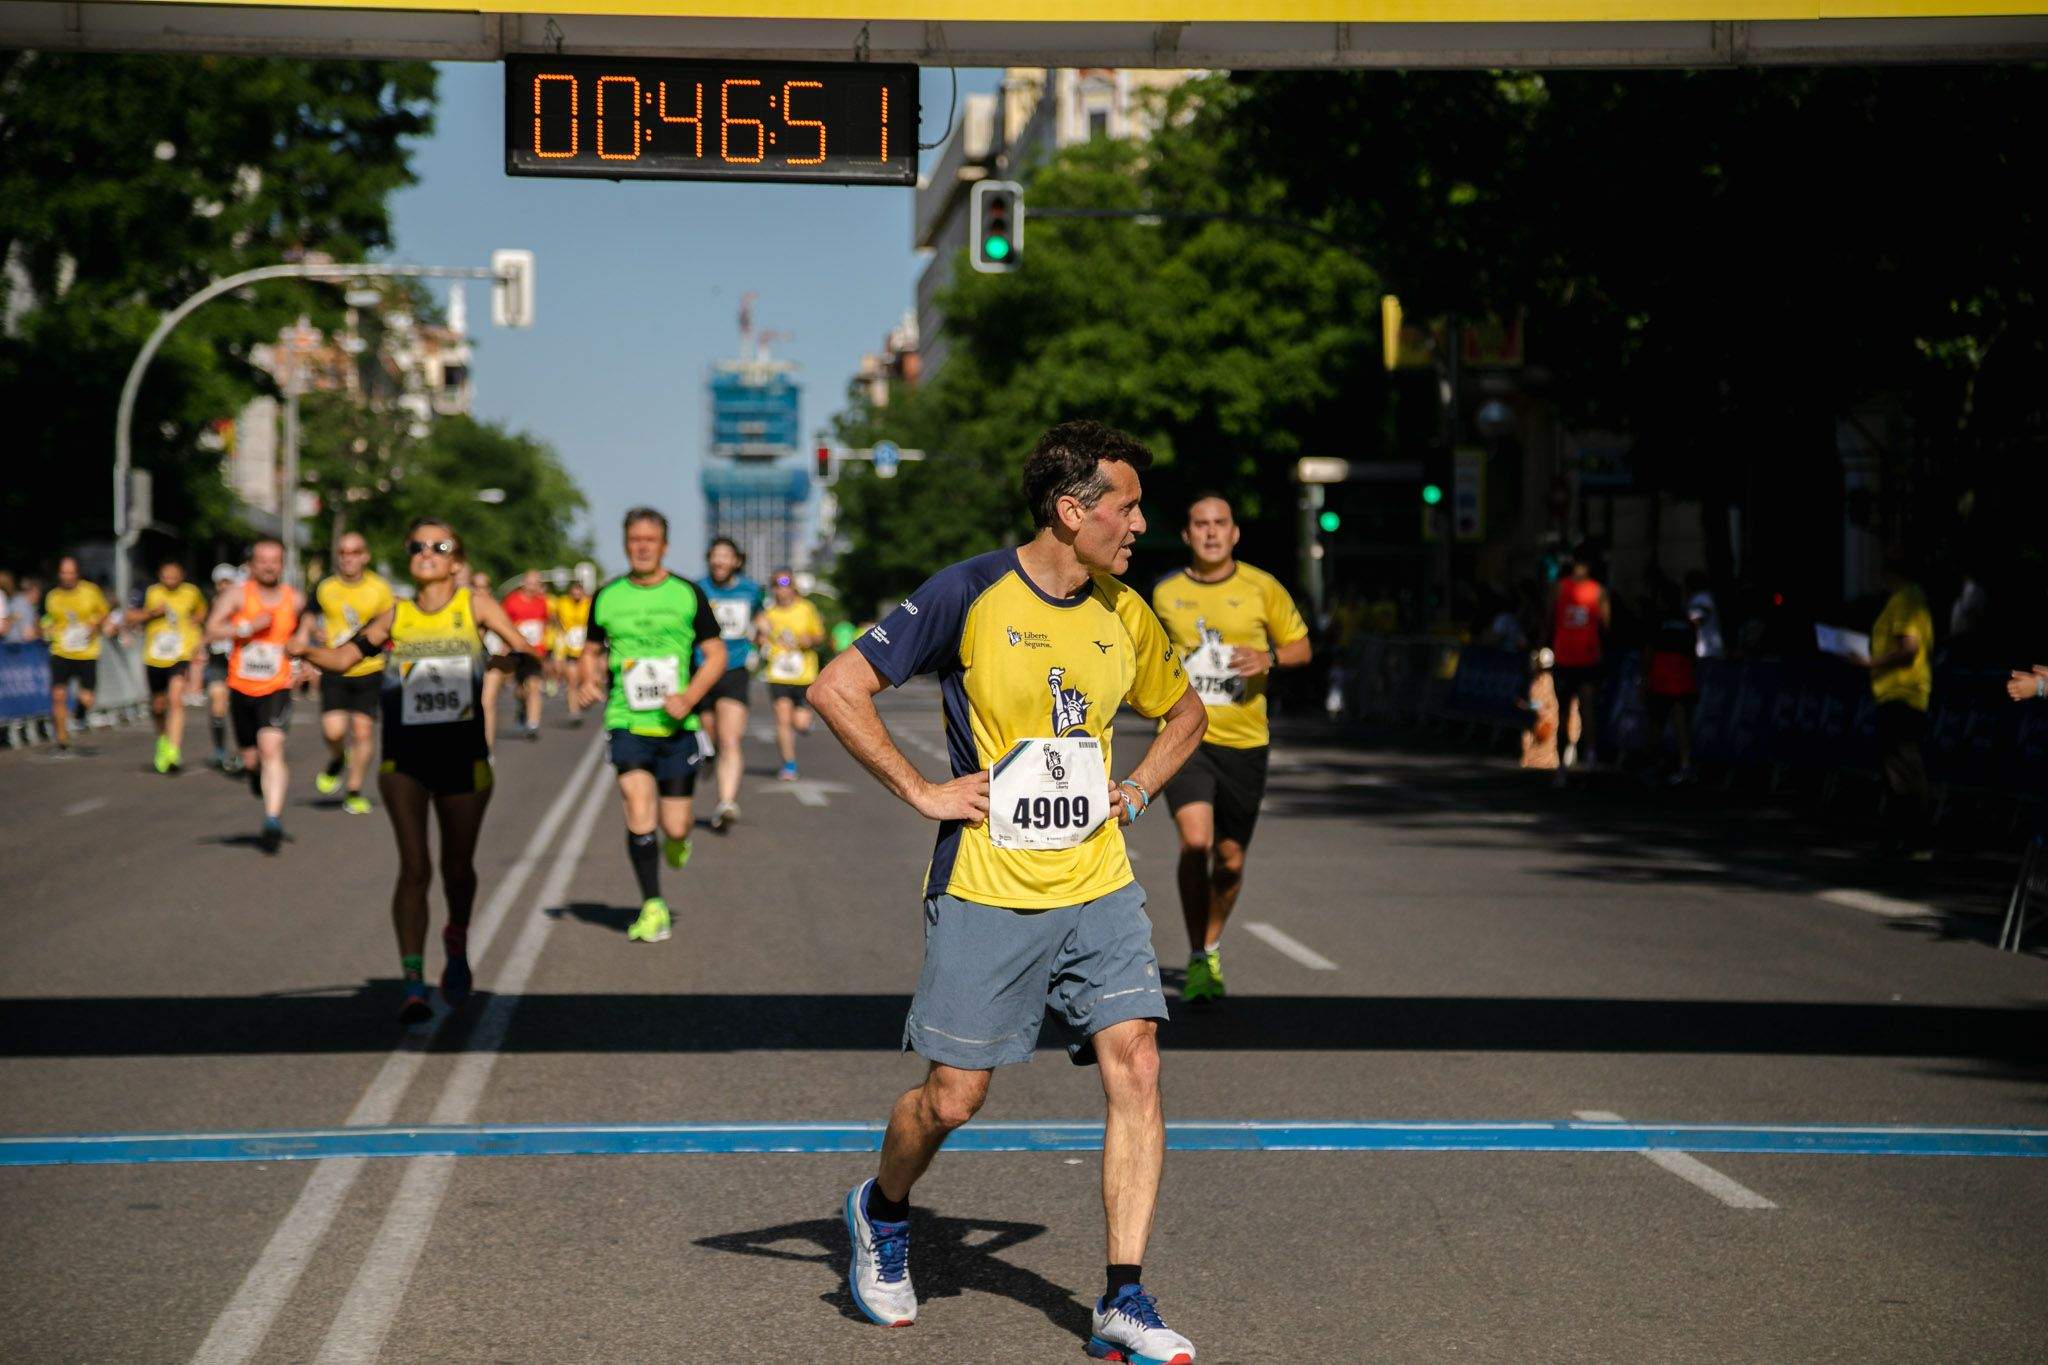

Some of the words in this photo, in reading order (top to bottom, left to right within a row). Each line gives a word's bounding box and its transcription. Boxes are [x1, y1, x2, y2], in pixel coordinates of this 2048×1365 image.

[1024, 632, 1048, 640] Liberty
[1054, 769, 1063, 778] 13
[1013, 795, 1089, 829] 4909
